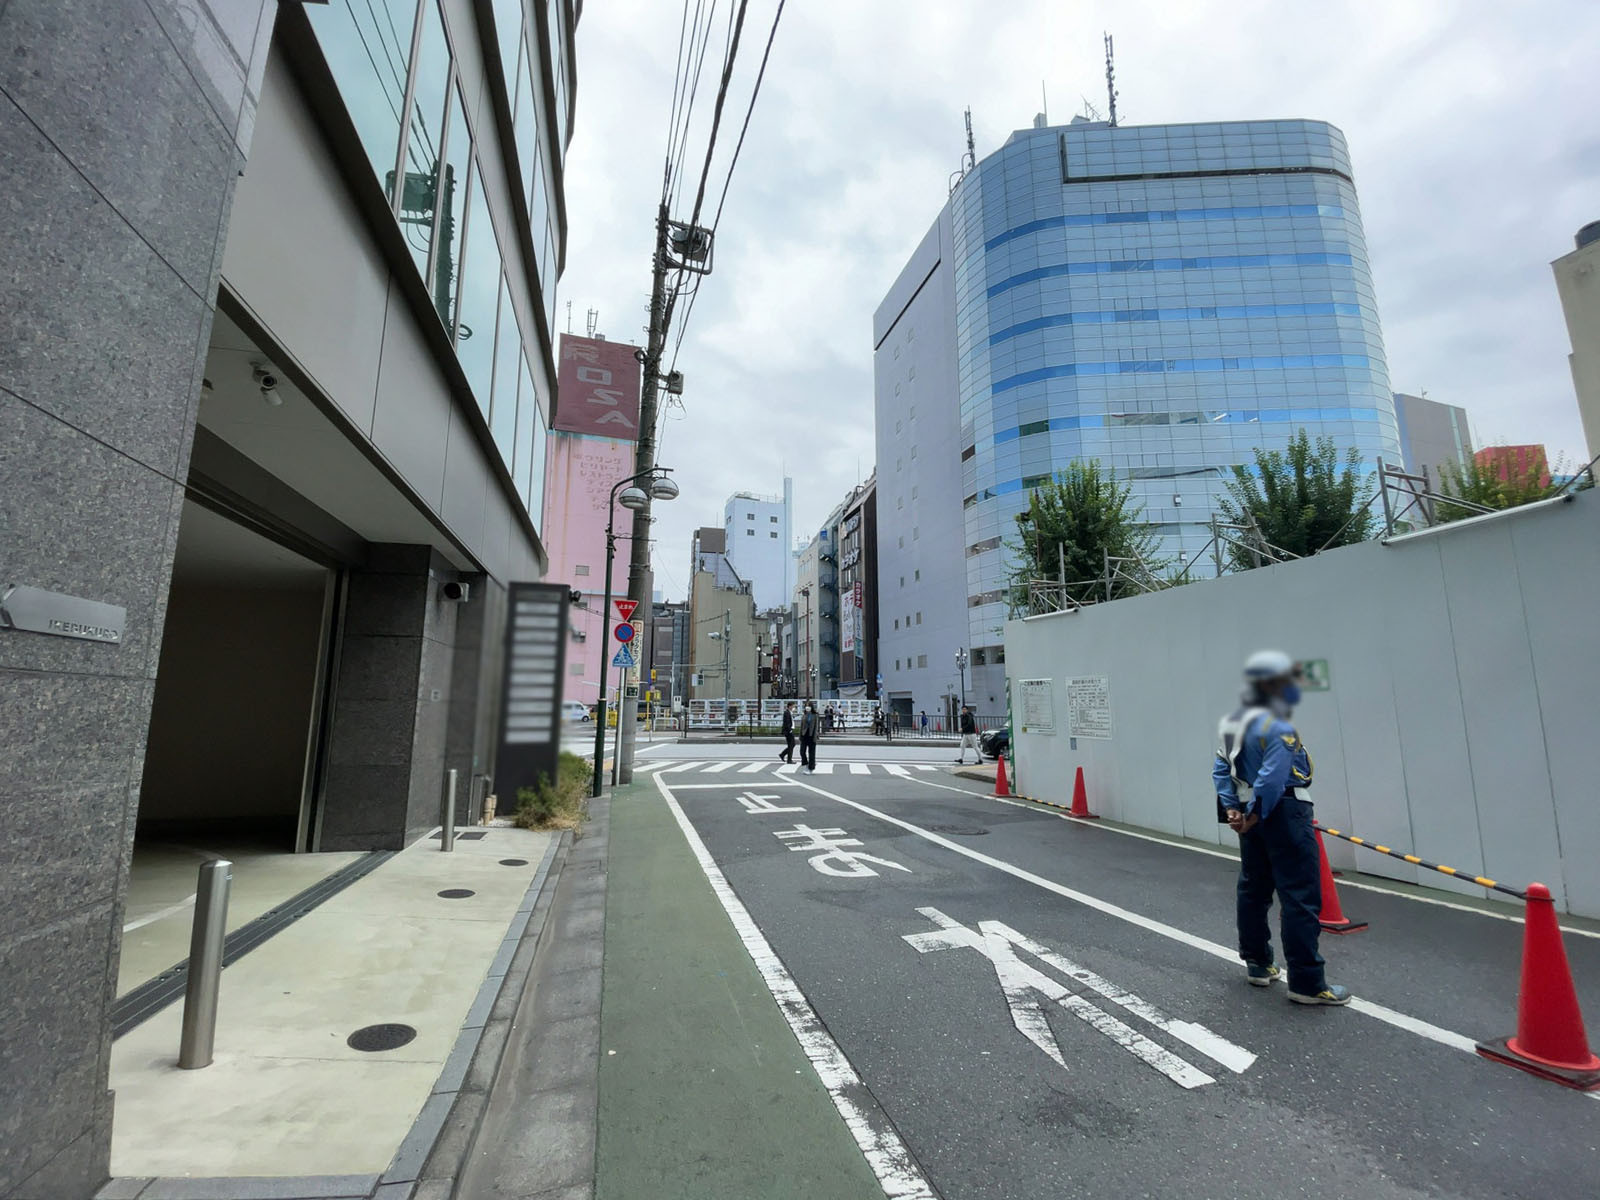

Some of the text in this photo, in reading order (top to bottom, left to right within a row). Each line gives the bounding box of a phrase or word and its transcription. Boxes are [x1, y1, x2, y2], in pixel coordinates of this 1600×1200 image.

[563, 343, 634, 428] ROSA
[48, 619, 119, 640] IKEBUKURO
[735, 790, 1258, 1090] 止まれ
